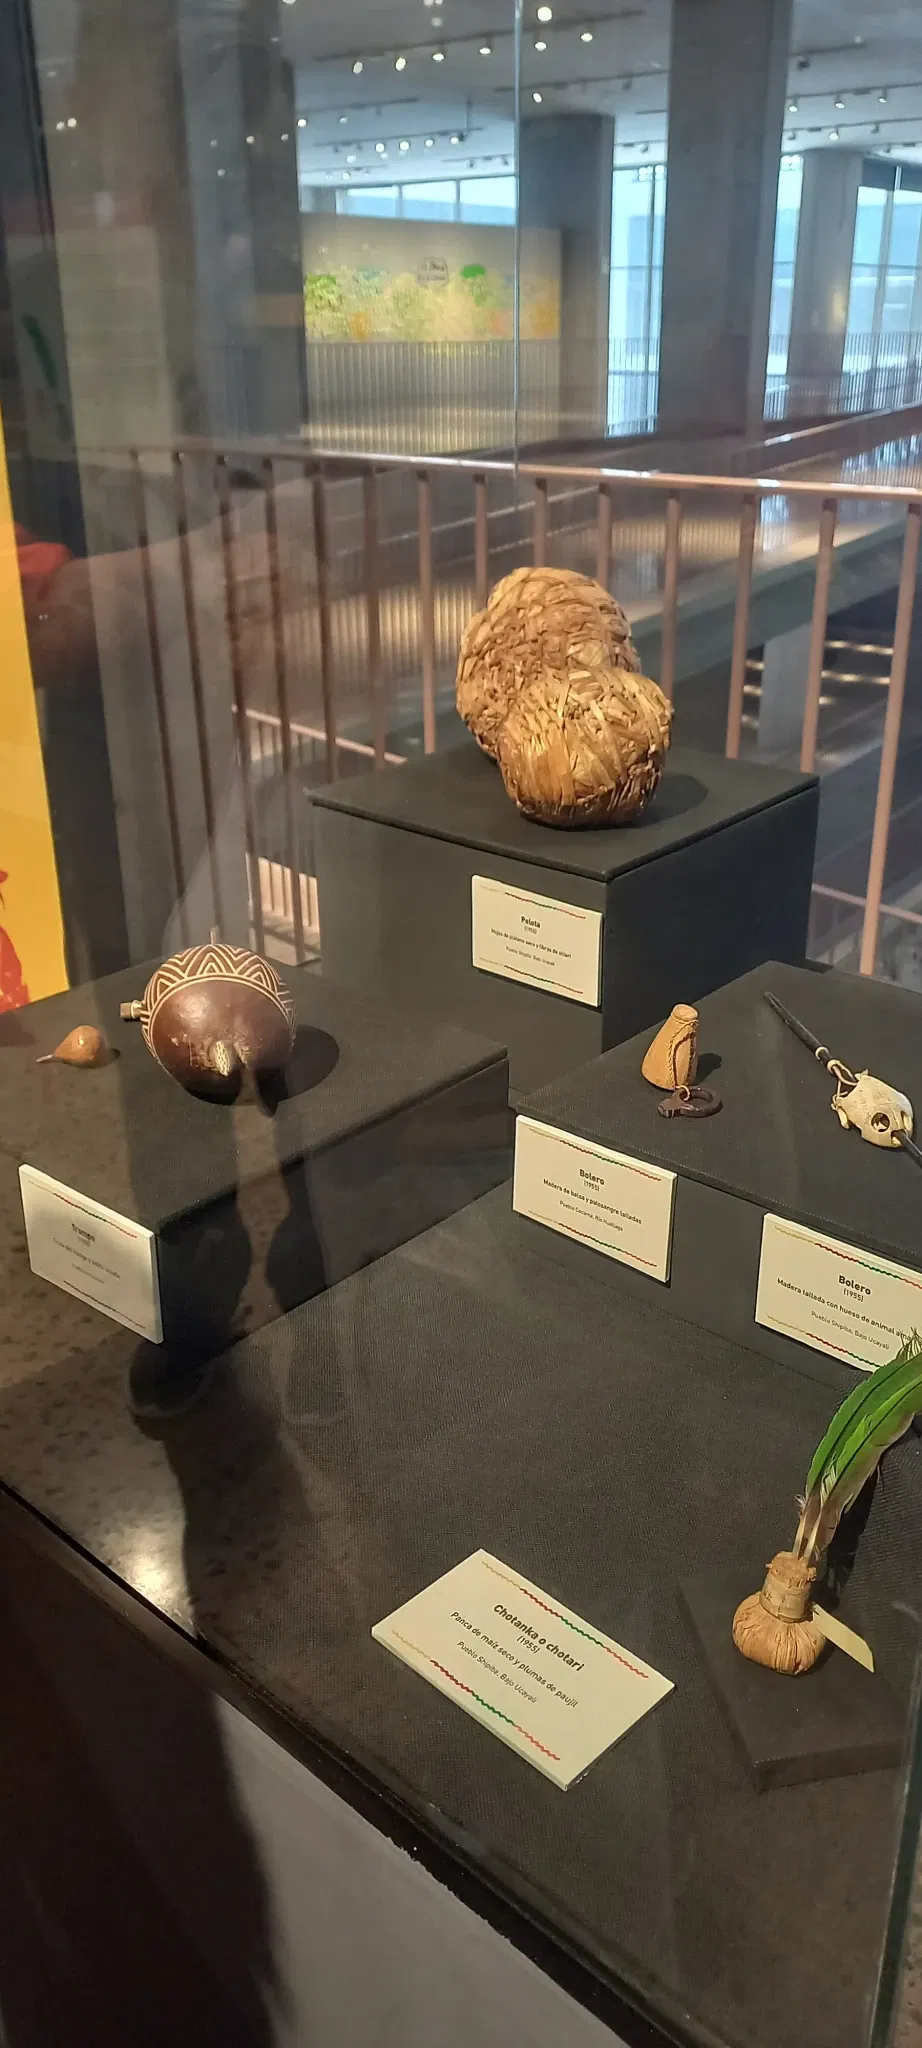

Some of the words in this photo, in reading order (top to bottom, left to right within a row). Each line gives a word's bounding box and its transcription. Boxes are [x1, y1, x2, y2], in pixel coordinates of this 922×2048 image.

[521, 916, 540, 928] Pelota
[580, 1169, 604, 1185] Bolero
[584, 1180, 600, 1192] (1955)
[544, 1178, 562, 1191] Madera
[570, 1190, 584, 1200] balsa
[590, 1199, 619, 1214] palosangre
[620, 1210, 642, 1224] talladas
[560, 1200, 574, 1210] Pueblo
[838, 1275, 871, 1295] Bolero
[844, 1288, 864, 1302] (1955)
[778, 1278, 801, 1294] Madera
[802, 1289, 826, 1304] tallada
[826, 1300, 838, 1310] con
[840, 1305, 860, 1319] hueso
[861, 1316, 870, 1324] de
[870, 1320, 894, 1336] animal
[812, 1311, 830, 1324] Pueblo
[854, 1330, 868, 1340] Bajo
[868, 1336, 890, 1350] Ucayali
[494, 1604, 539, 1640] Chotanka
[546, 1642, 584, 1672] chotari
[516, 1636, 540, 1654] (1955)
[451, 1612, 472, 1630] Panca
[472, 1627, 482, 1636] de
[480, 1634, 498, 1650] maíz
[498, 1647, 514, 1661] seco
[518, 1662, 546, 1685] plumas
[546, 1680, 556, 1692] de
[555, 1690, 578, 1708] paujil
[457, 1641, 478, 1658] Pueblo
[500, 1673, 514, 1686] Bajo
[514, 1683, 537, 1703] Ucayali
